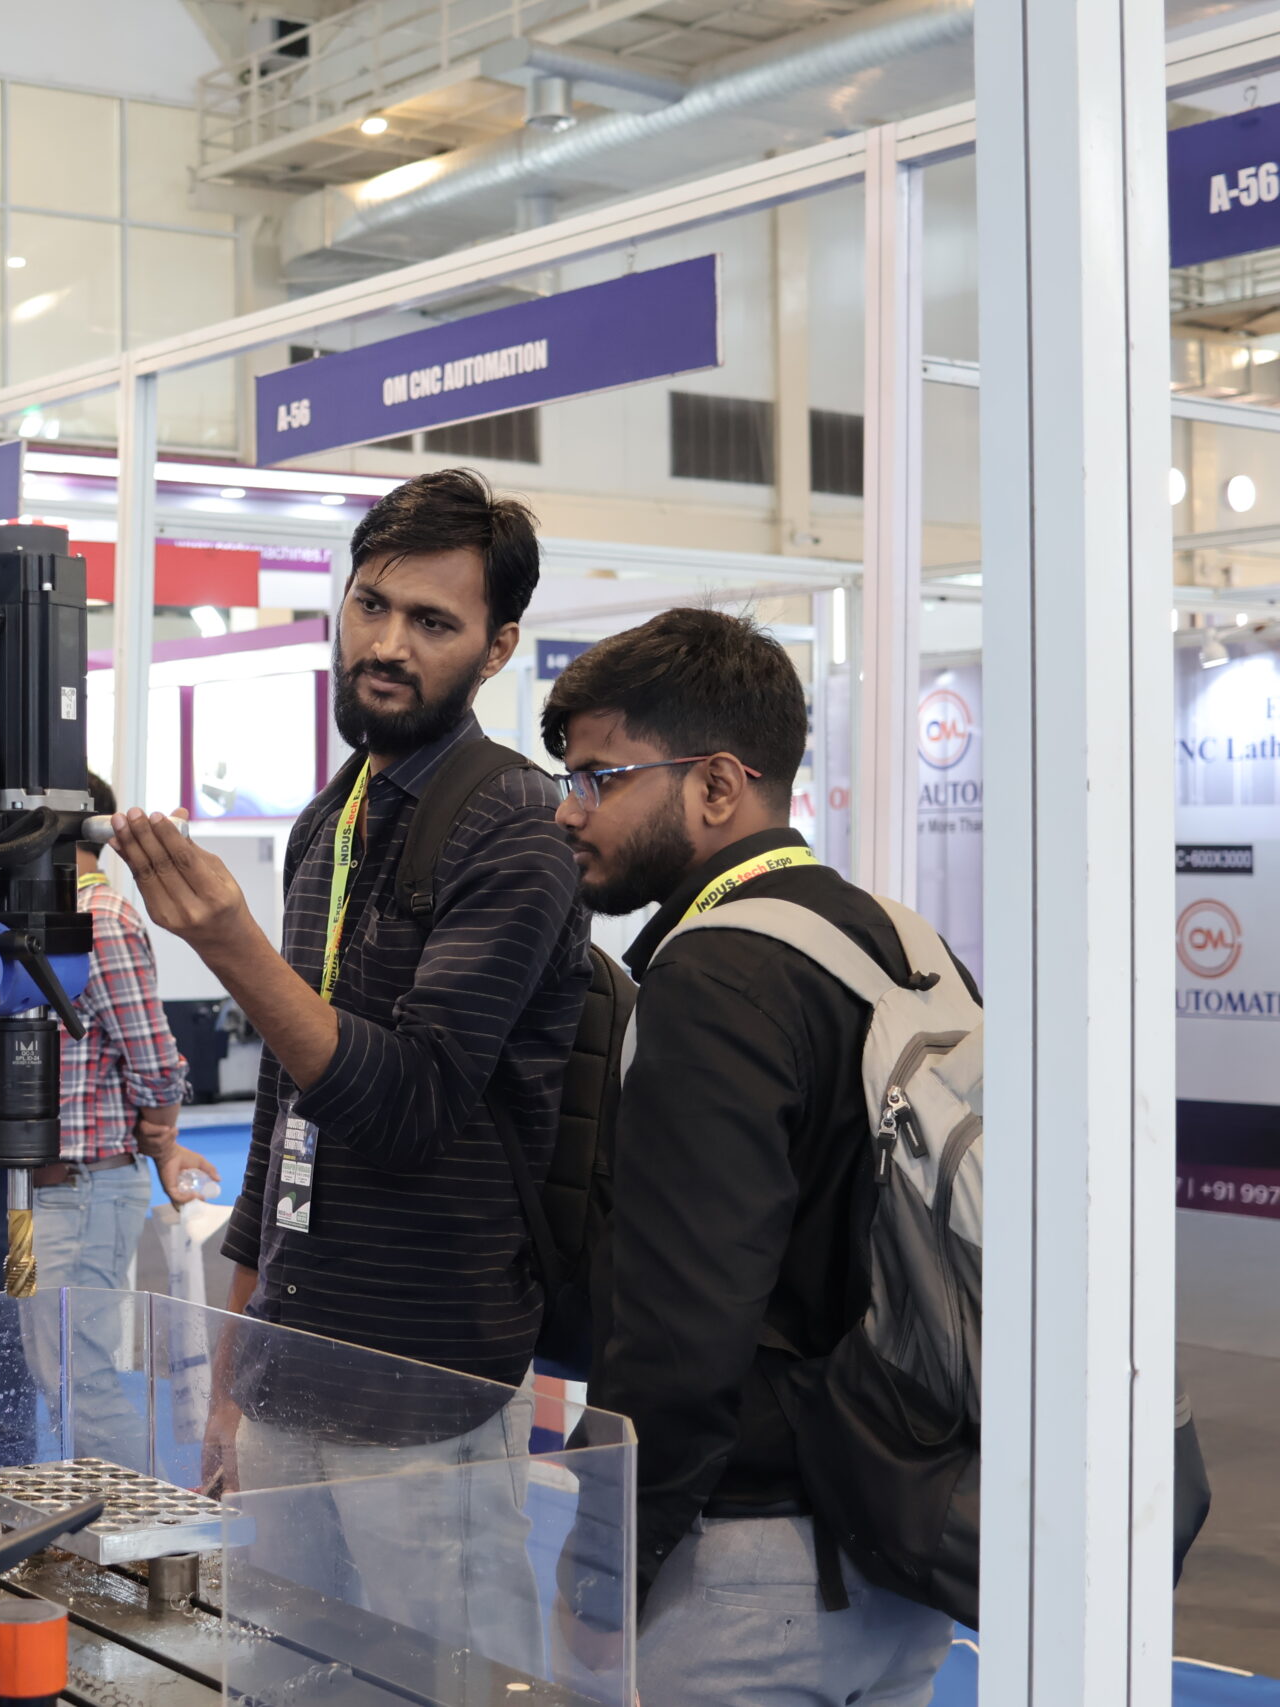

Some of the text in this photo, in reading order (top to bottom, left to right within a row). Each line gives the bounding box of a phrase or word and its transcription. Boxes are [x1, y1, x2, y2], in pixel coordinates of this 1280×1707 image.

[1209, 162, 1280, 214] A-56
[383, 338, 548, 406] OM CNC AUTOMATION
[277, 398, 311, 432] A-56
[766, 856, 793, 872] Expo
[1200, 1180, 1235, 1202] +91
